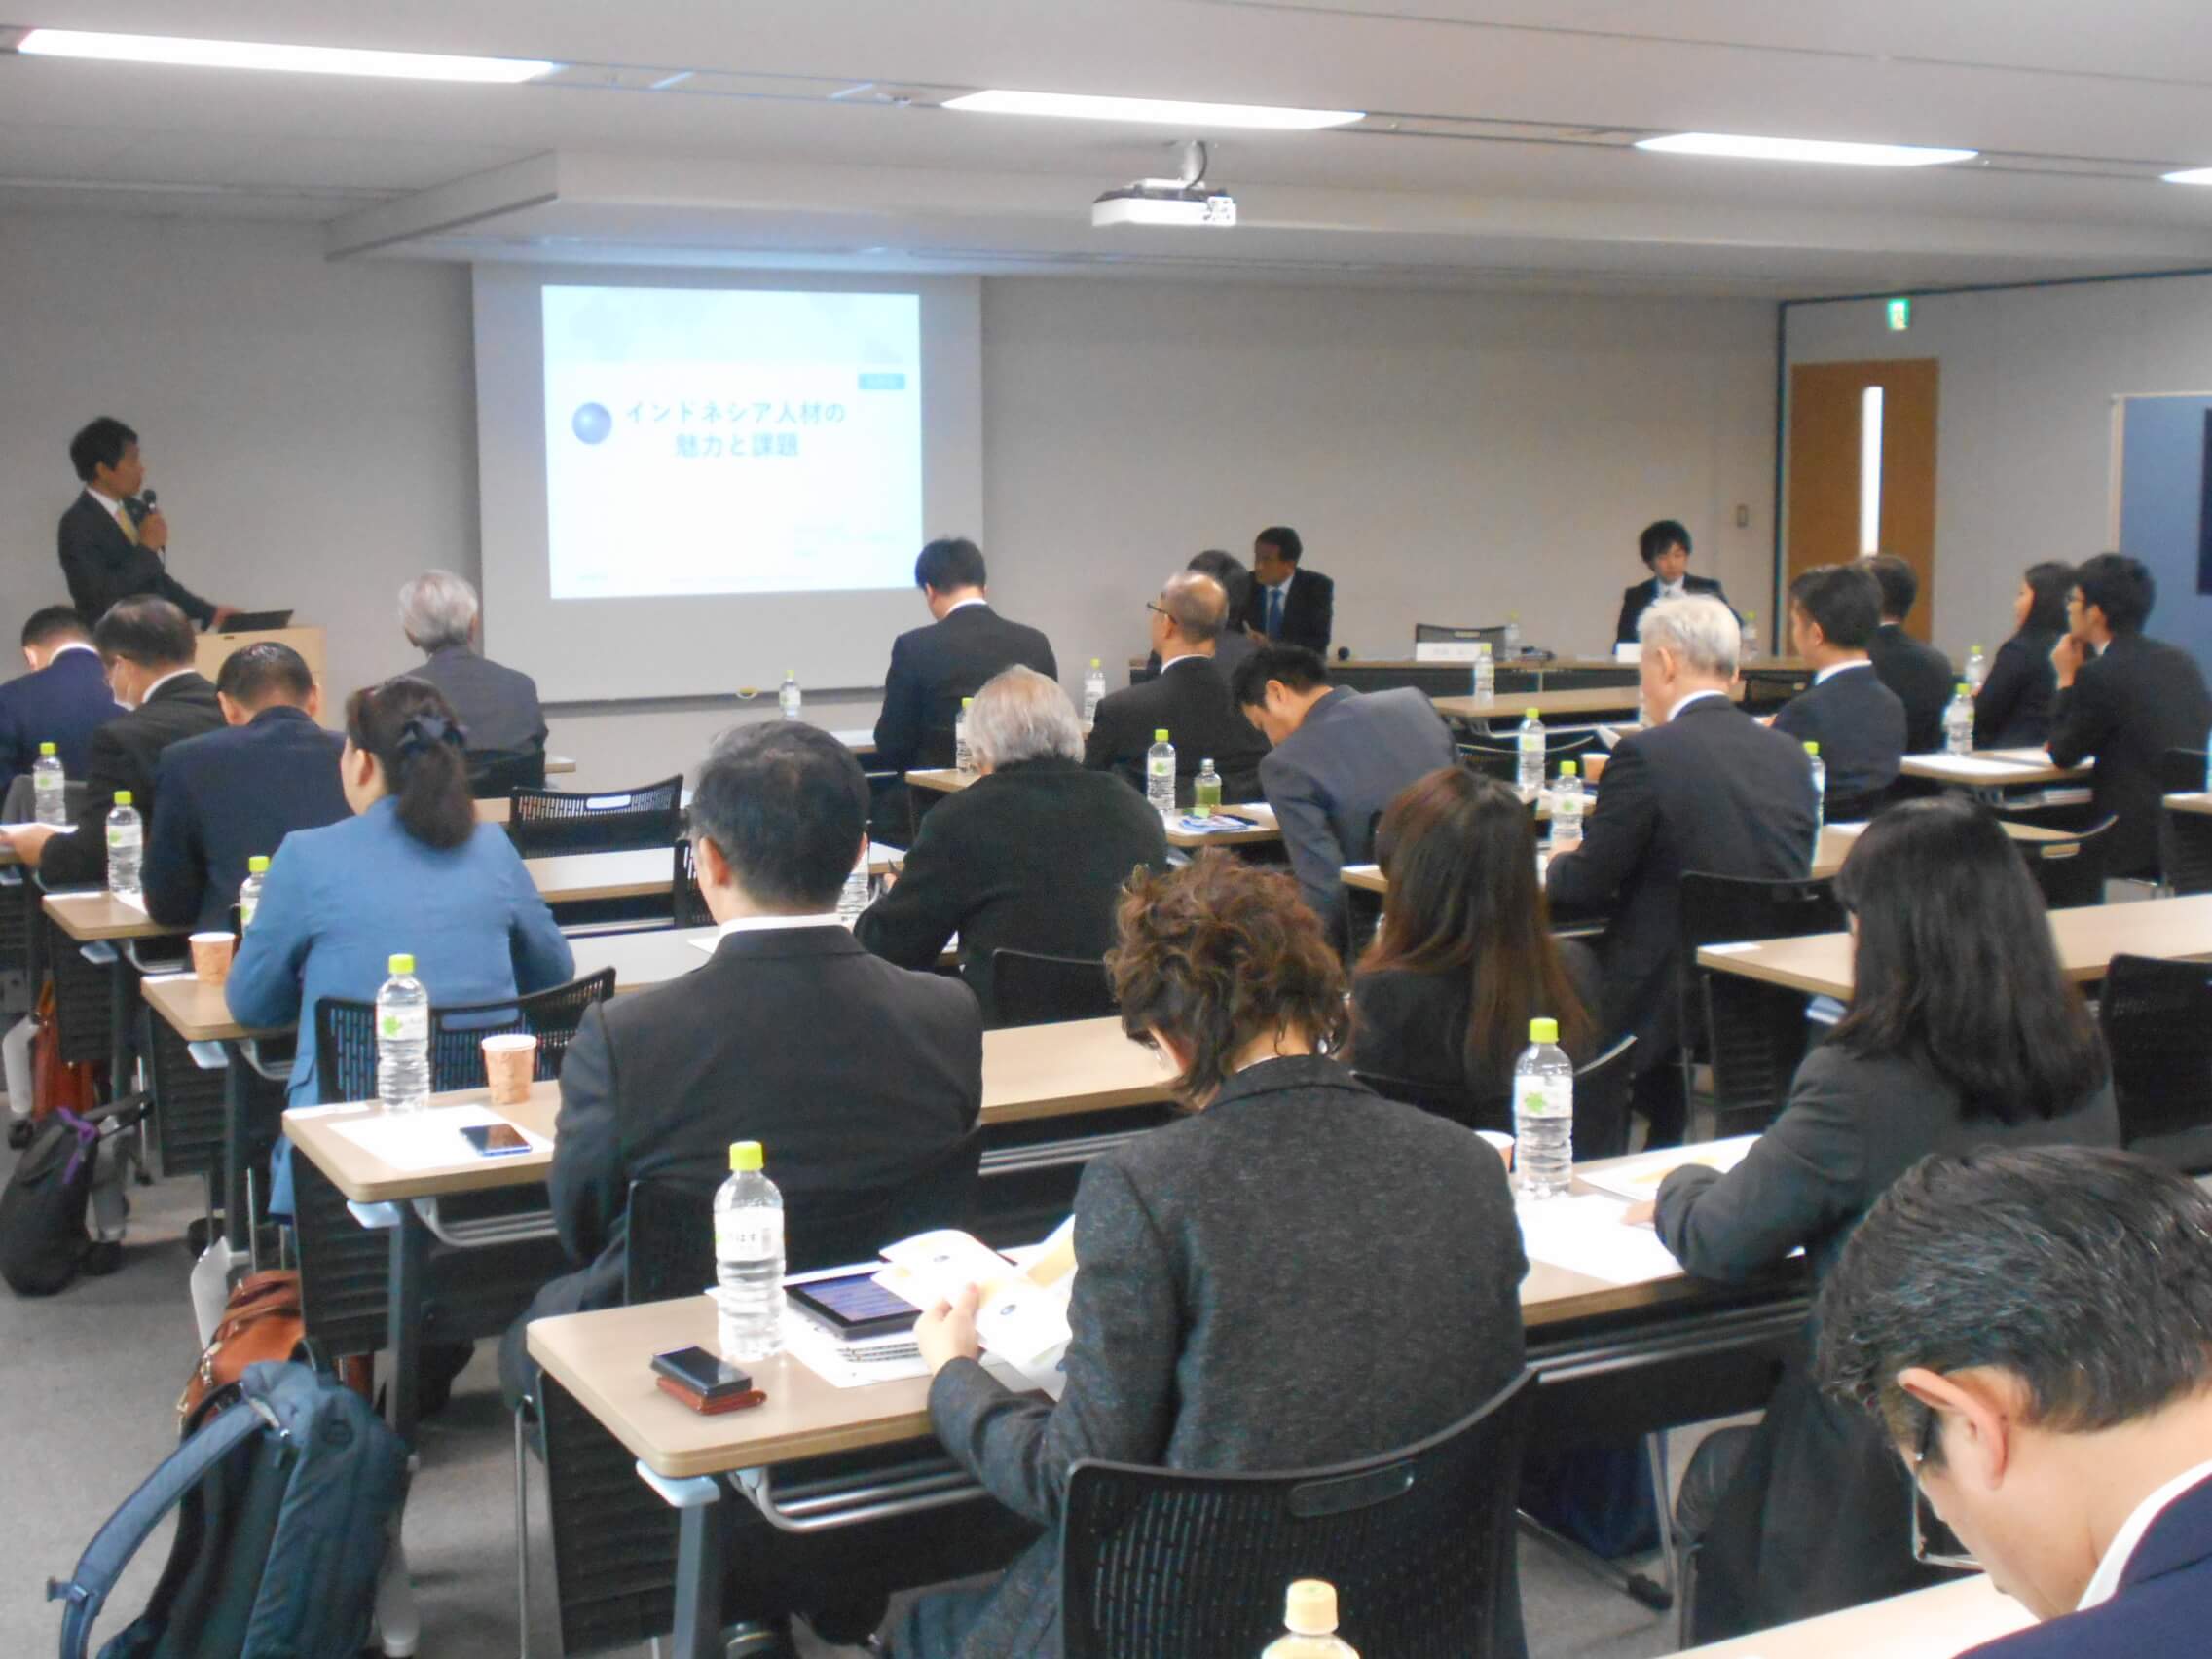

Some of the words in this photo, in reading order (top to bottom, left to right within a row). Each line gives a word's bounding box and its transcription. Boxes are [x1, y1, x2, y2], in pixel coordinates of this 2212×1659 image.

[626, 400, 845, 424] インドネシア人材の
[676, 432, 799, 458] 魅力と課題
